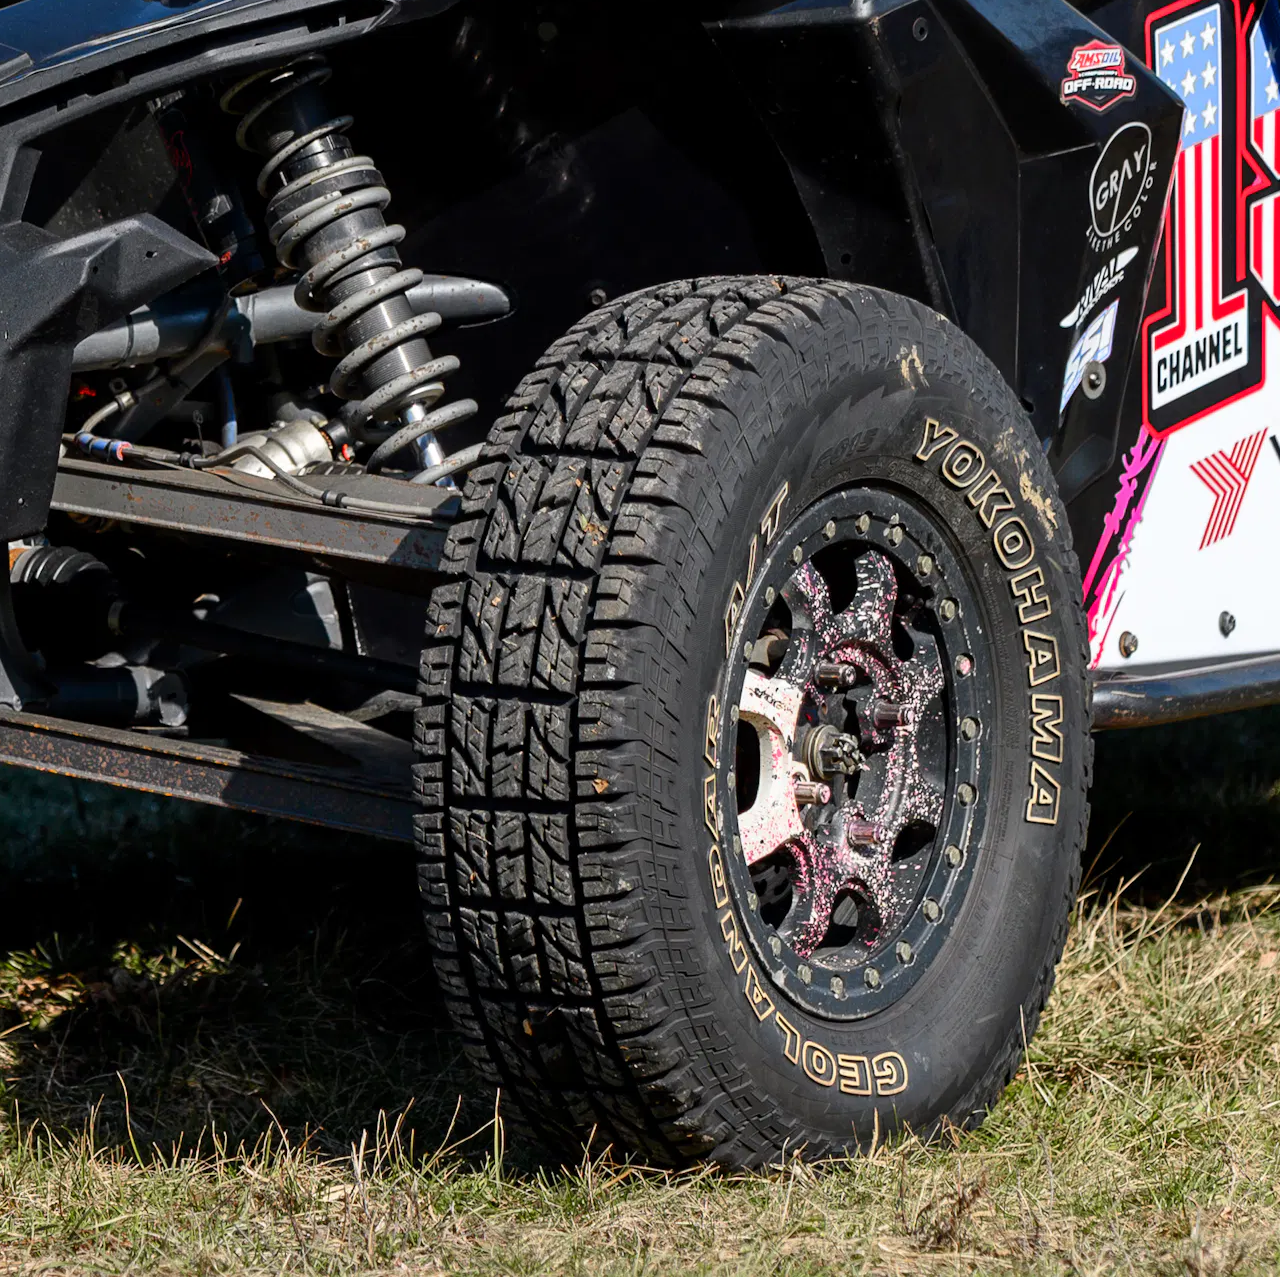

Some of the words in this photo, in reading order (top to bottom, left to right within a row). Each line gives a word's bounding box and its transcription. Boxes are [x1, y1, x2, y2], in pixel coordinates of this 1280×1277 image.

[1075, 51, 1120, 69] AMSOIL
[1095, 143, 1147, 211] GRAY
[1124, 161, 1158, 232] COLOR
[1157, 322, 1243, 394] CHANNEL
[916, 416, 1064, 826] YOKOHAMA
[701, 693, 908, 1097] GEOLANDAR
